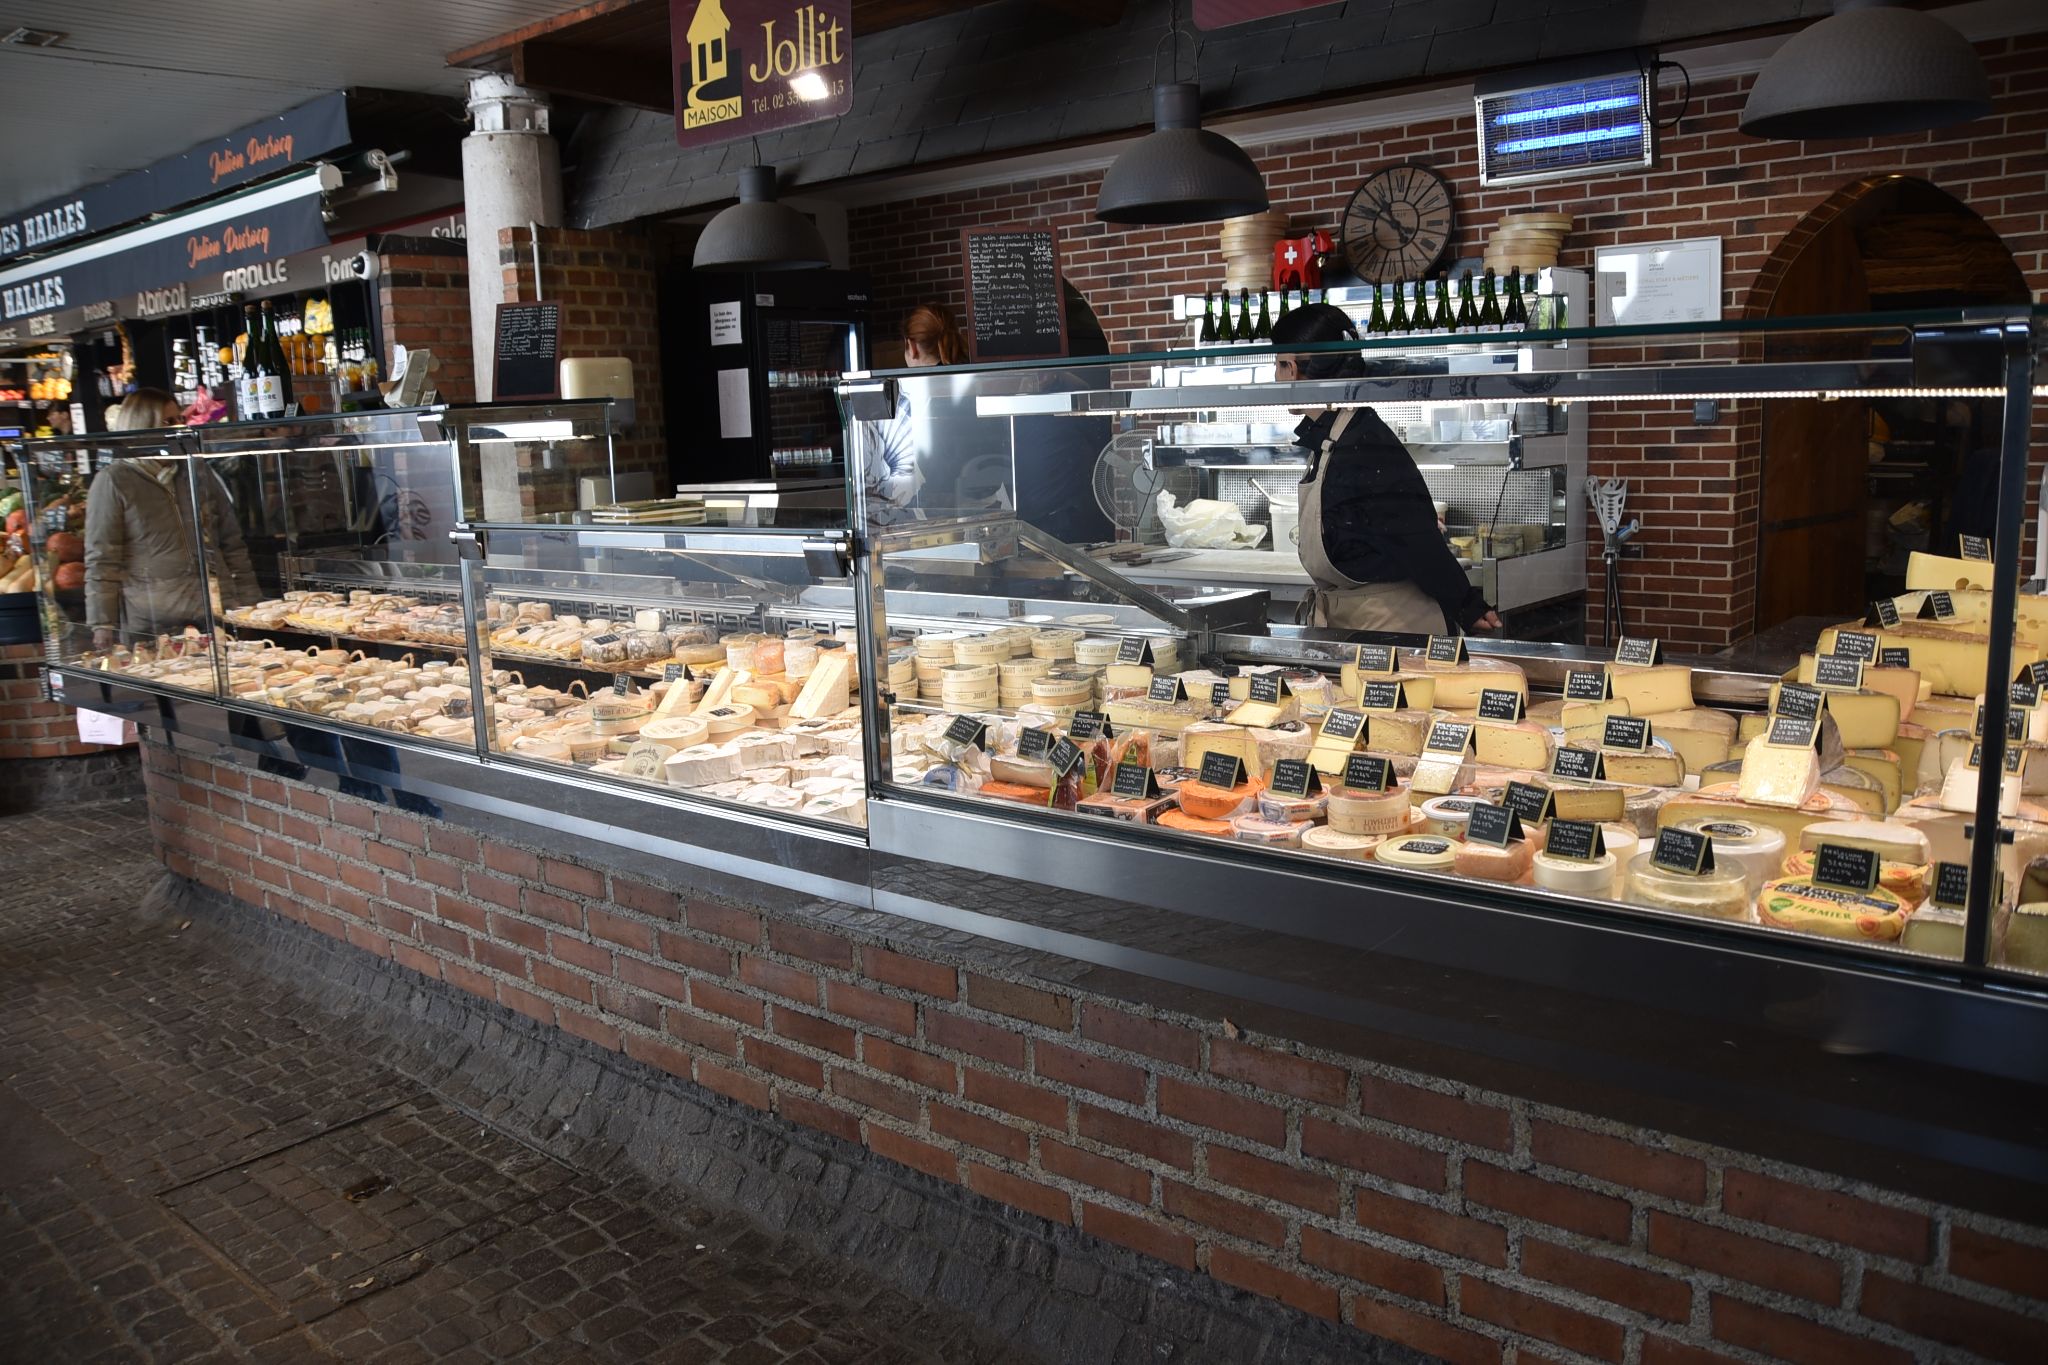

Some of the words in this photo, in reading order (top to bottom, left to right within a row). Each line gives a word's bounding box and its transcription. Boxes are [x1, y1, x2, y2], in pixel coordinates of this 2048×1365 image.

[750, 4, 844, 83] Jollit
[687, 101, 738, 126] MAISON
[752, 97, 769, 113] Tél.
[772, 94, 784, 108] 02
[23, 200, 87, 247] HALLES
[222, 258, 288, 292] GIROLLE
[3, 276, 65, 318] HALLES
[137, 282, 188, 317] Abricot
